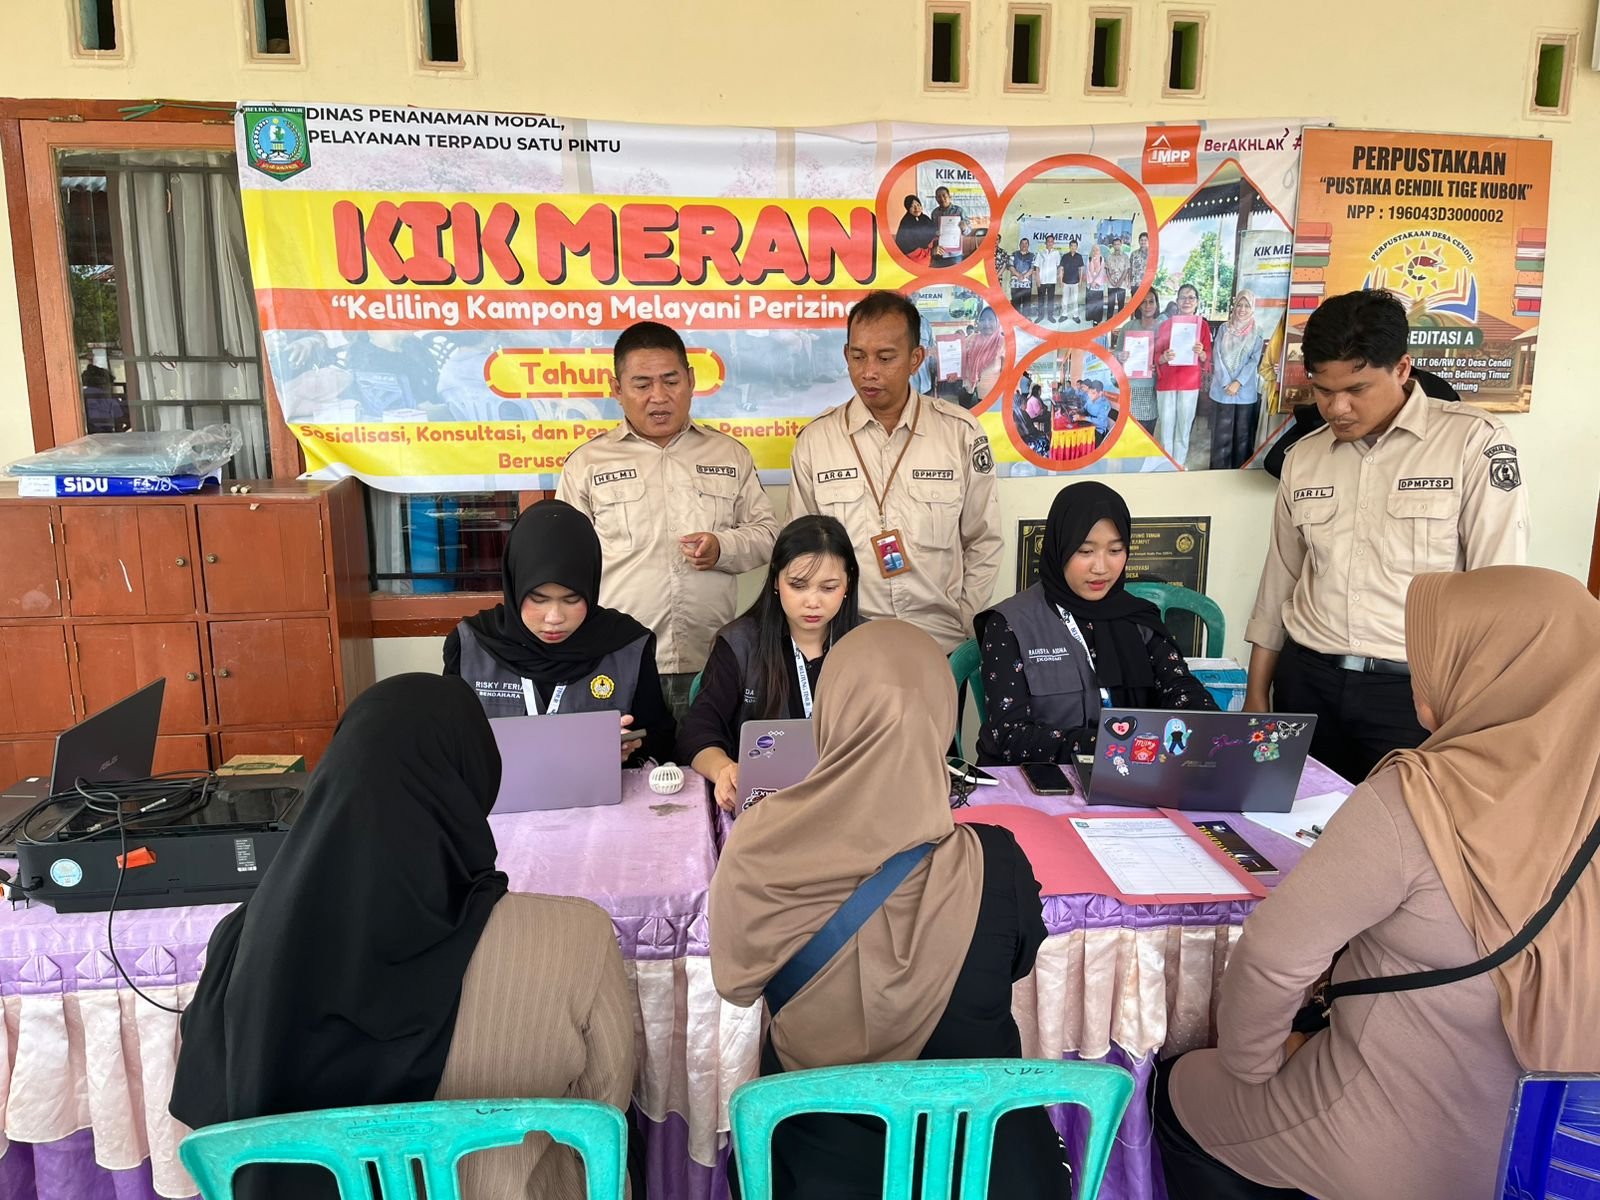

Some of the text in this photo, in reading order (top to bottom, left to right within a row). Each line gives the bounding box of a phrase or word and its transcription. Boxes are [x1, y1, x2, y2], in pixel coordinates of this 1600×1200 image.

[306, 107, 565, 131] DINAS PENANAMAN MODAL,
[308, 130, 621, 153] PELAYANAN TERPADU SATU PINTU
[1204, 138, 1285, 152] BerAKHLAK
[1158, 150, 1190, 162] MPP
[1352, 146, 1506, 175] PERPUSTAKAAN
[935, 169, 954, 179] KIK
[1320, 177, 1533, 200] “PUSTAKA CENDIL TIGE KUBOK”
[1347, 204, 1375, 219] NPP
[1388, 206, 1504, 223] 196043D3000002
[333, 200, 877, 286] KIK MERAN
[1370, 230, 1474, 263] PERPUSTAKAAN DESA CENDIL
[1254, 246, 1271, 256] KIK
[331, 294, 460, 326] “Keliling
[466, 294, 603, 326] Kampong
[611, 294, 741, 325] Melayani
[1407, 331, 1474, 345] EDITASI A
[1429, 359, 1454, 367] 06/RW
[1468, 359, 1486, 367] Desa
[1488, 359, 1512, 367] Cendil
[520, 361, 612, 385] Tahun
[1455, 371, 1486, 380] Belitung
[1488, 371, 1510, 379] Timur
[300, 425, 411, 445] Sosialisasi,
[416, 423, 526, 444] Konsultasi,
[532, 424, 568, 440] dan
[597, 472, 633, 483] HELMI
[824, 471, 852, 481] ARGA
[914, 471, 952, 479] DPMPTSP
[64, 477, 109, 493] SiDU
[1400, 479, 1450, 488] DPMPTSP
[1295, 489, 1327, 498] FARIL
[475, 681, 499, 689] RISKY
